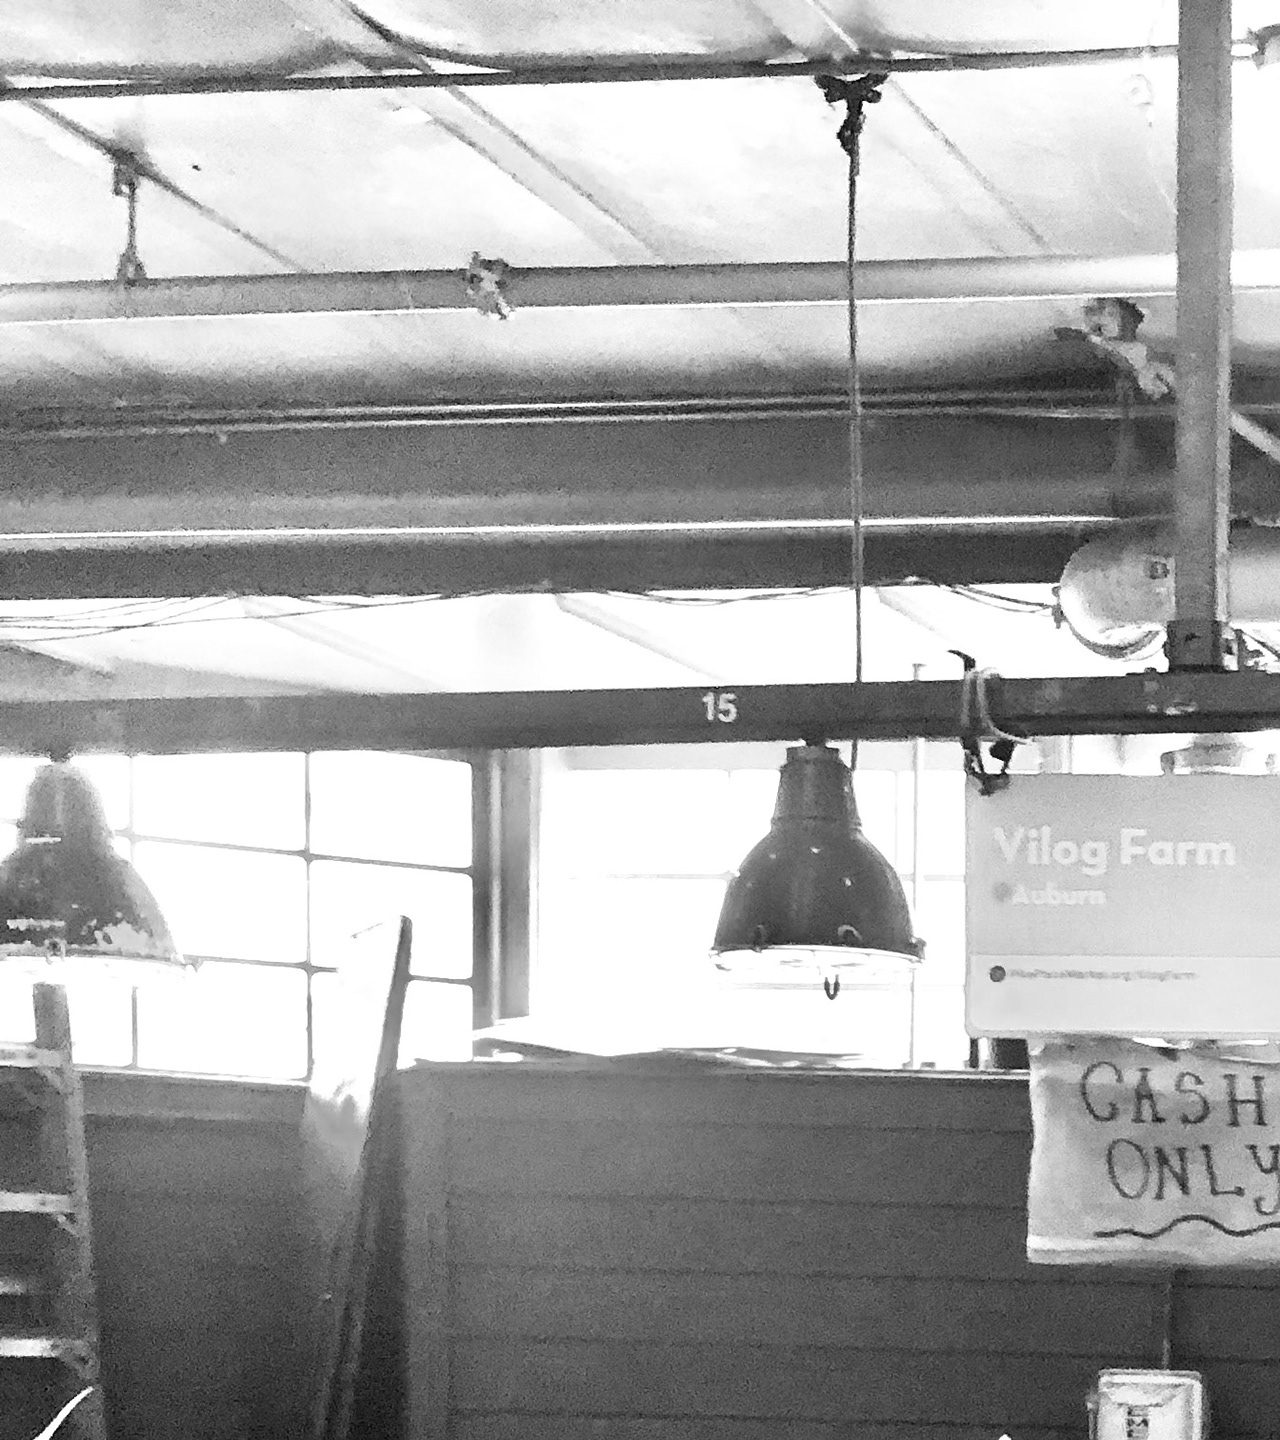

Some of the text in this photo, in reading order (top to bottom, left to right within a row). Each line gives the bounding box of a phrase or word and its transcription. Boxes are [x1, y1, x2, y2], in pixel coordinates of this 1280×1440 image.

[702, 691, 738, 722] 15
[993, 824, 1236, 876] Vilog Farm
[1079, 1061, 1268, 1128] CASH
